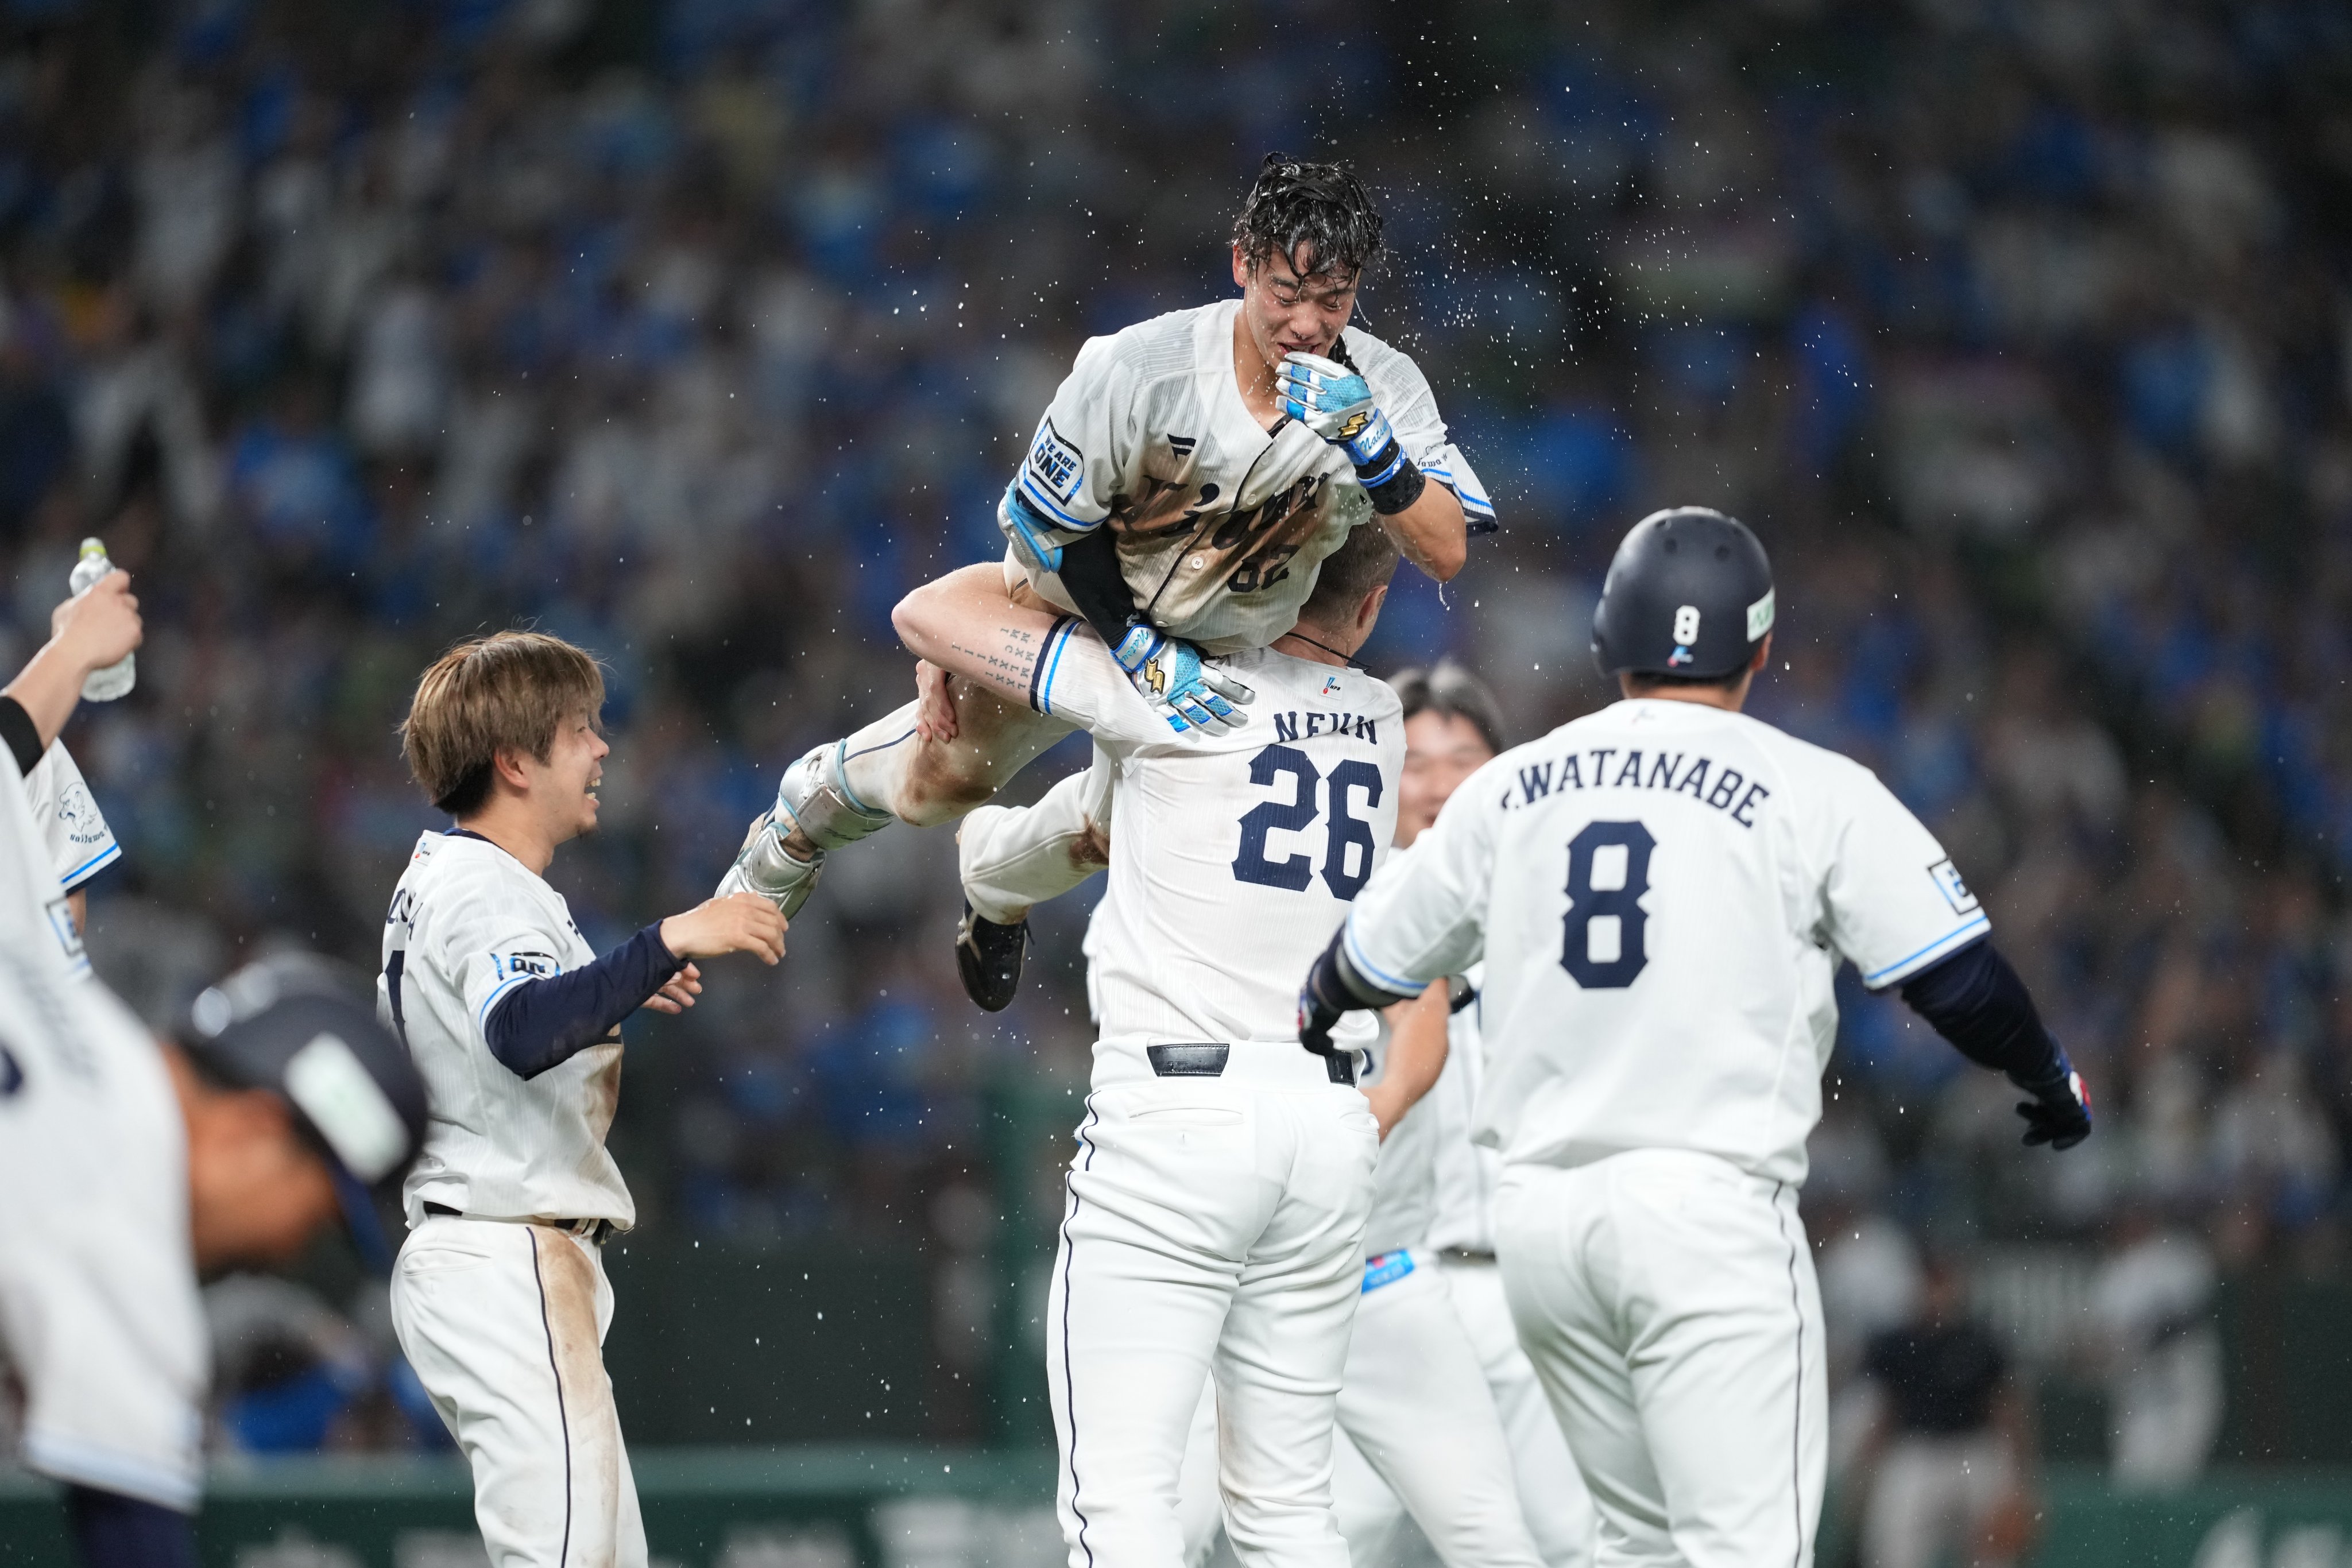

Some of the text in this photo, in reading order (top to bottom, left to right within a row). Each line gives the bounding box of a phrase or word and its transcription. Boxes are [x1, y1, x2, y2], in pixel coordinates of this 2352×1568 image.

[1034, 443, 1070, 488] ONE
[1045, 434, 1077, 471] WE ARE
[1672, 605, 1701, 646] 8
[1231, 744, 1383, 902] 26
[1559, 820, 1657, 989] 8
